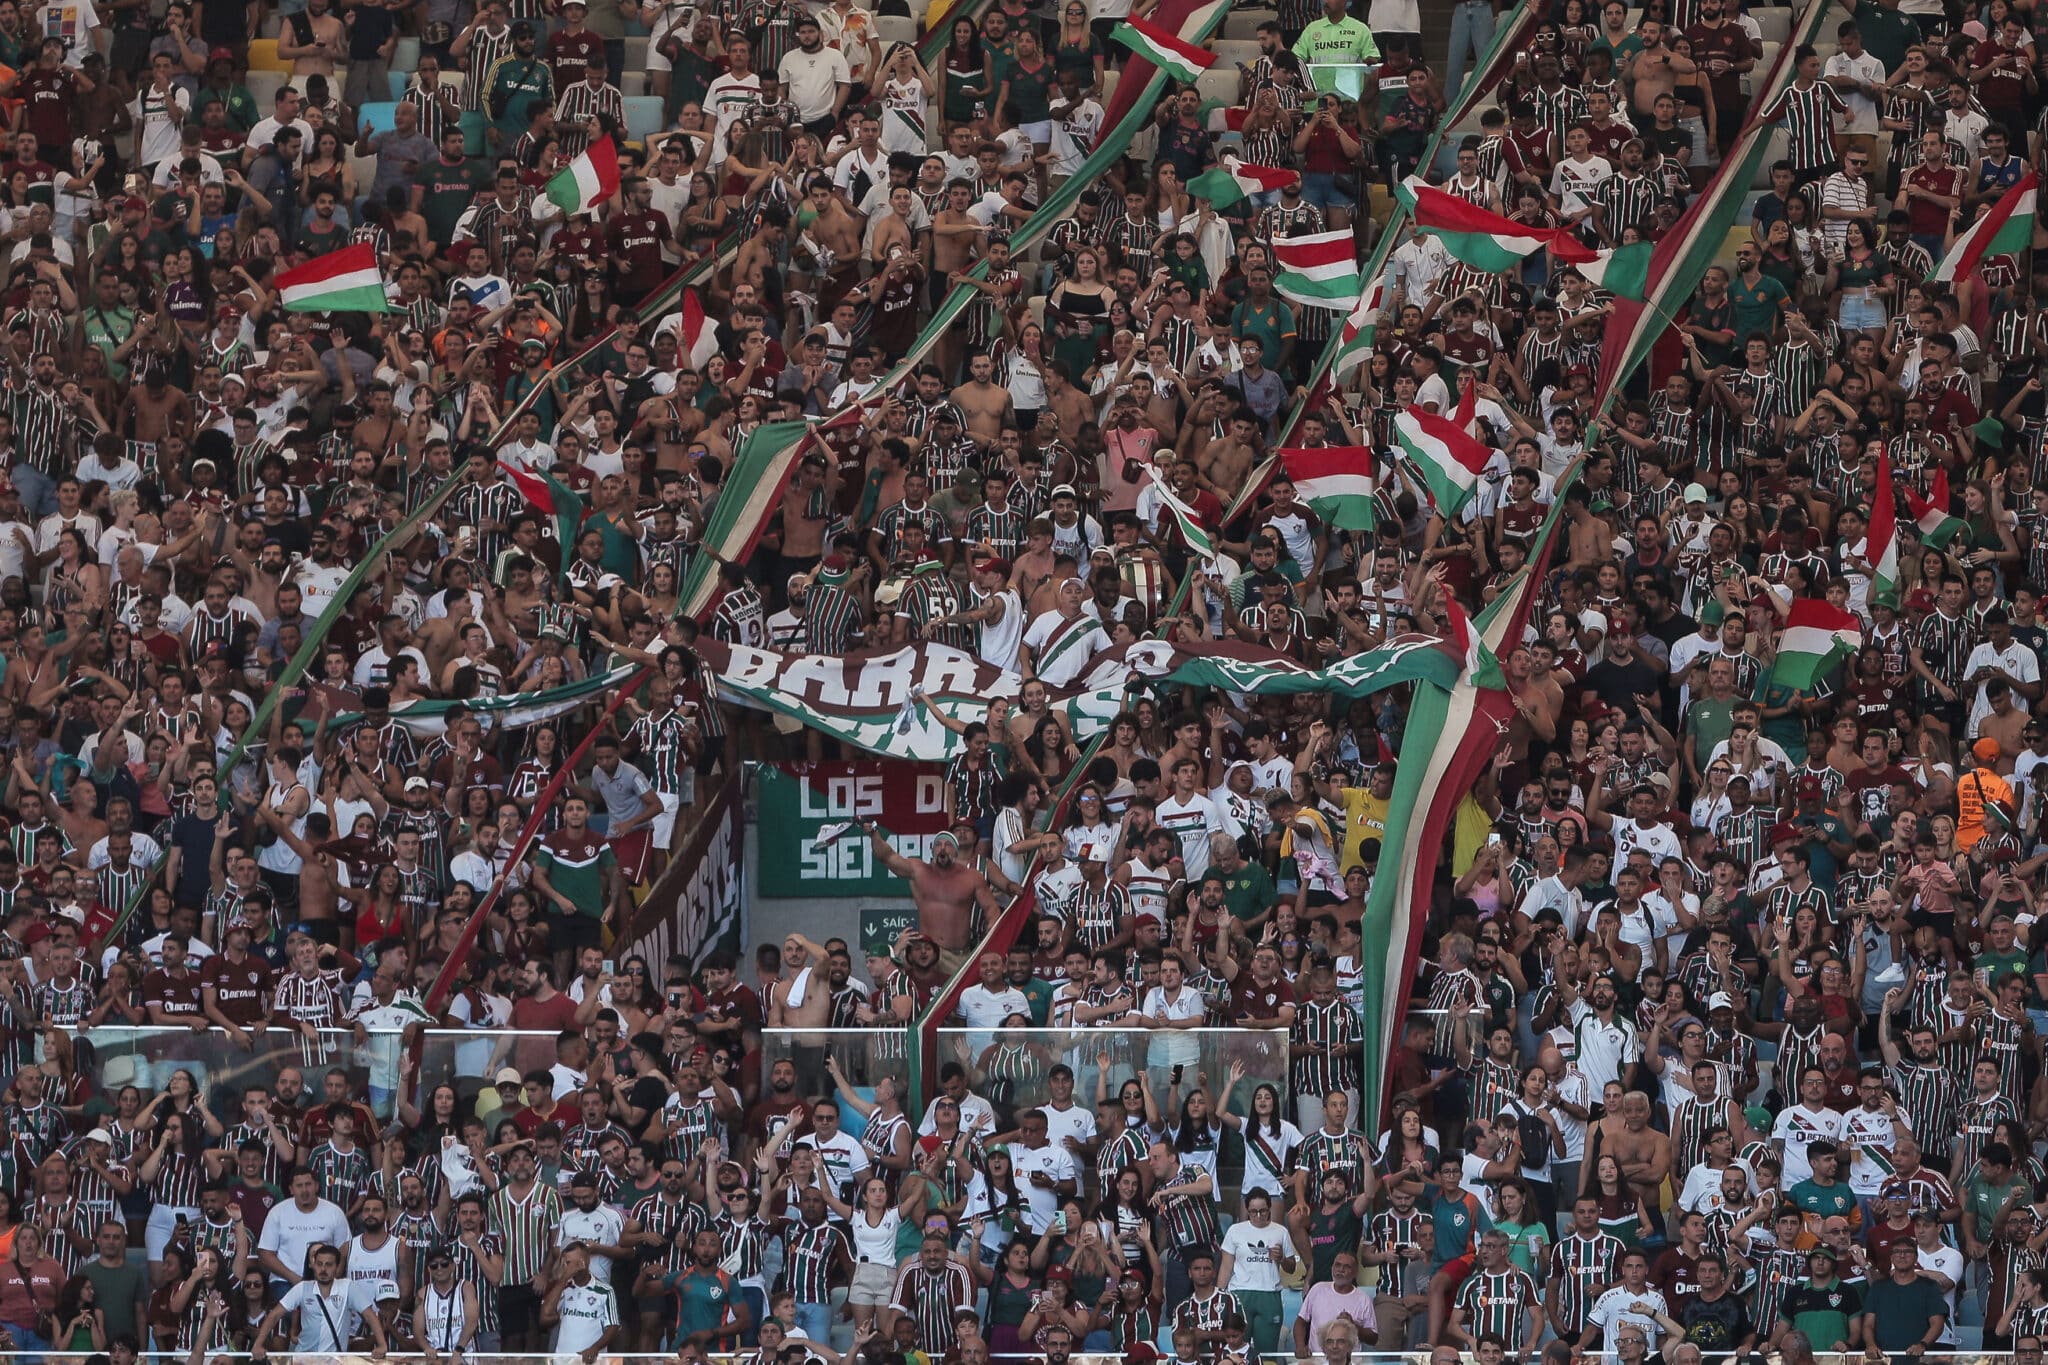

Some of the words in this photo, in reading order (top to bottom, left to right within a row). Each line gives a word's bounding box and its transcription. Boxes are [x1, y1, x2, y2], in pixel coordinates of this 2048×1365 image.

[1314, 41, 1352, 51] SUNSET
[2001, 70, 2021, 80] BETANO
[1129, 248, 1151, 256] BETANO
[1662, 436, 1687, 445] BETANO
[1908, 462, 1923, 470] BETA
[929, 597, 957, 617] 52
[748, 620, 760, 637] 9
[800, 775, 883, 818] LOS
[915, 775, 948, 814] D
[1366, 819, 1384, 829] BETA
[1046, 899, 1070, 909] Unim
[1085, 919, 1111, 927] BETANO
[1794, 966, 1813, 974] BETA
[228, 990, 256, 998] BETANO
[292, 1007, 328, 1017] Unimed
[52, 1014, 81, 1022] BETANO
[677, 1124, 706, 1135] BETANO
[1858, 1134, 1888, 1142] BETANO
[1330, 1160, 1356, 1169] BETANO
[1577, 1266, 1606, 1274] BETANO
[1780, 1276, 1796, 1285] BETA
[563, 1308, 598, 1318] Unimed
